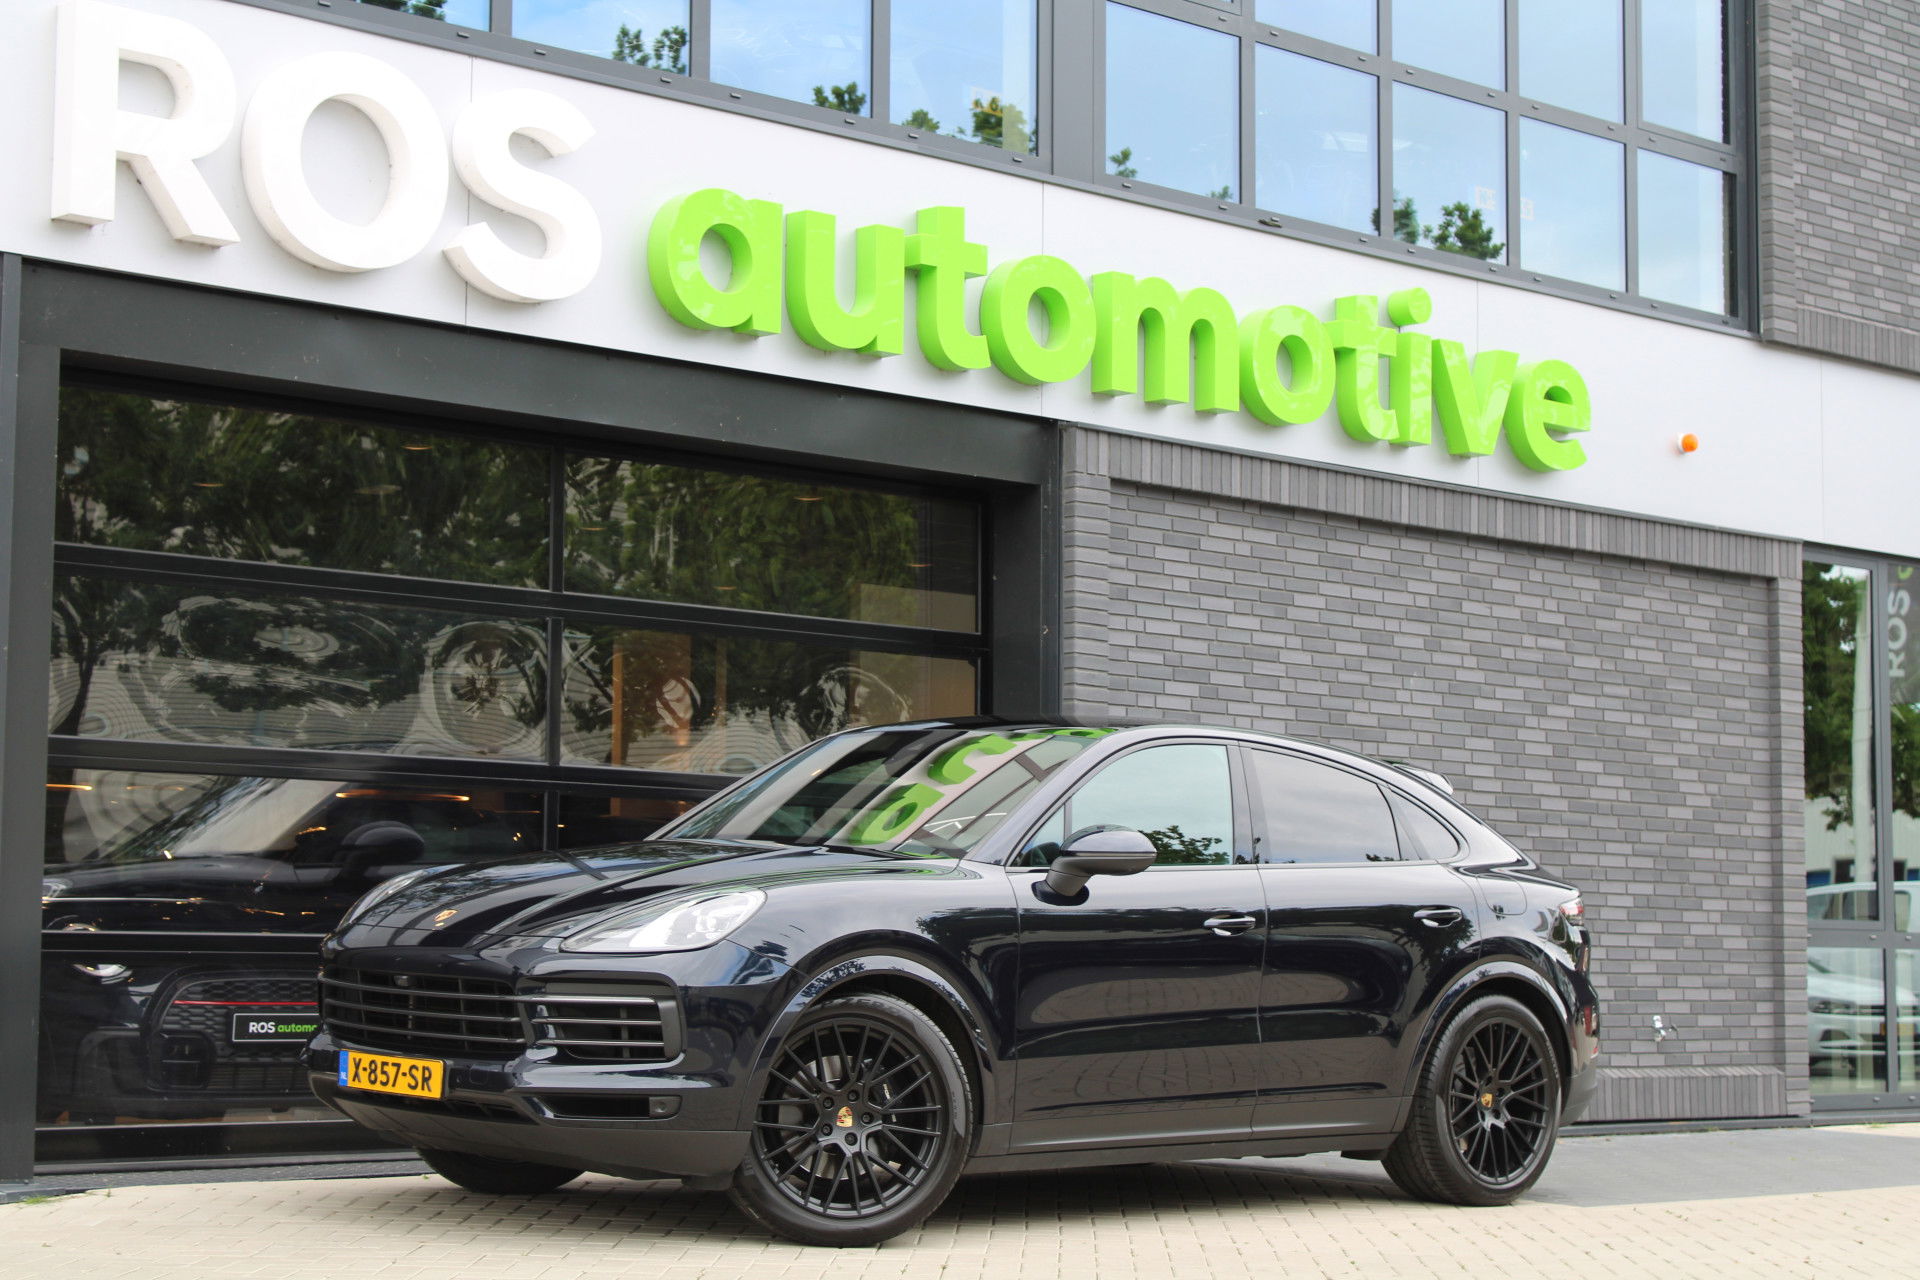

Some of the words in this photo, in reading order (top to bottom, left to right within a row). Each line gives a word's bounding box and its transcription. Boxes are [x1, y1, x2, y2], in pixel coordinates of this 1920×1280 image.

[51, 1, 602, 304] ROS
[647, 188, 1592, 471] automotive
[249, 1022, 276, 1034] ROS
[352, 1057, 433, 1092] X-857-SR
